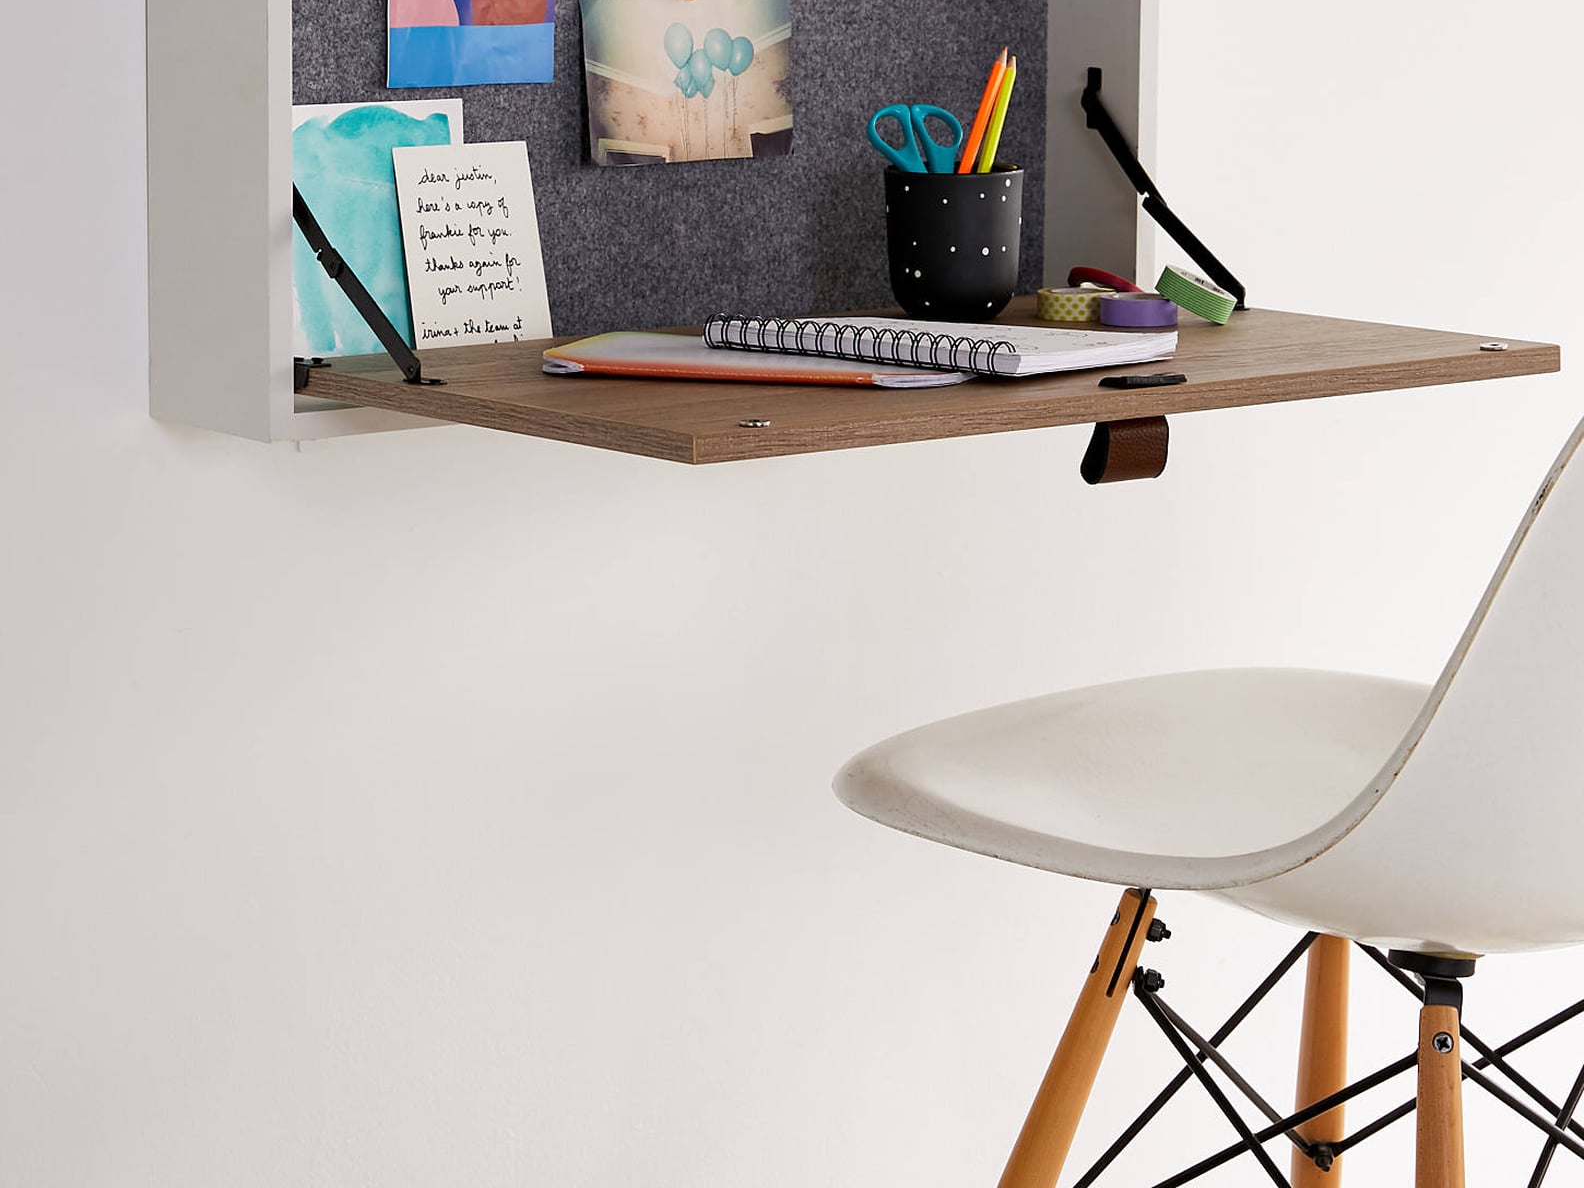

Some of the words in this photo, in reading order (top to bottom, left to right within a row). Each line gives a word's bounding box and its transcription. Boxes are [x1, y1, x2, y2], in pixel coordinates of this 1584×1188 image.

[418, 168, 449, 185] dear
[455, 164, 497, 190] justin,
[416, 196, 451, 213] here's
[455, 203, 462, 211] a
[467, 201, 494, 216] copy
[498, 196, 509, 219] of
[420, 223, 464, 250] frankie
[468, 223, 485, 246] for
[425, 256, 464, 272] thanks
[469, 252, 502, 276] again
[505, 253, 521, 276] for
[438, 284, 463, 305] your
[467, 276, 522, 300] support!
[421, 321, 452, 340] irina
[463, 319, 482, 334] the
[484, 319, 510, 333] team
[513, 316, 523, 330] at
